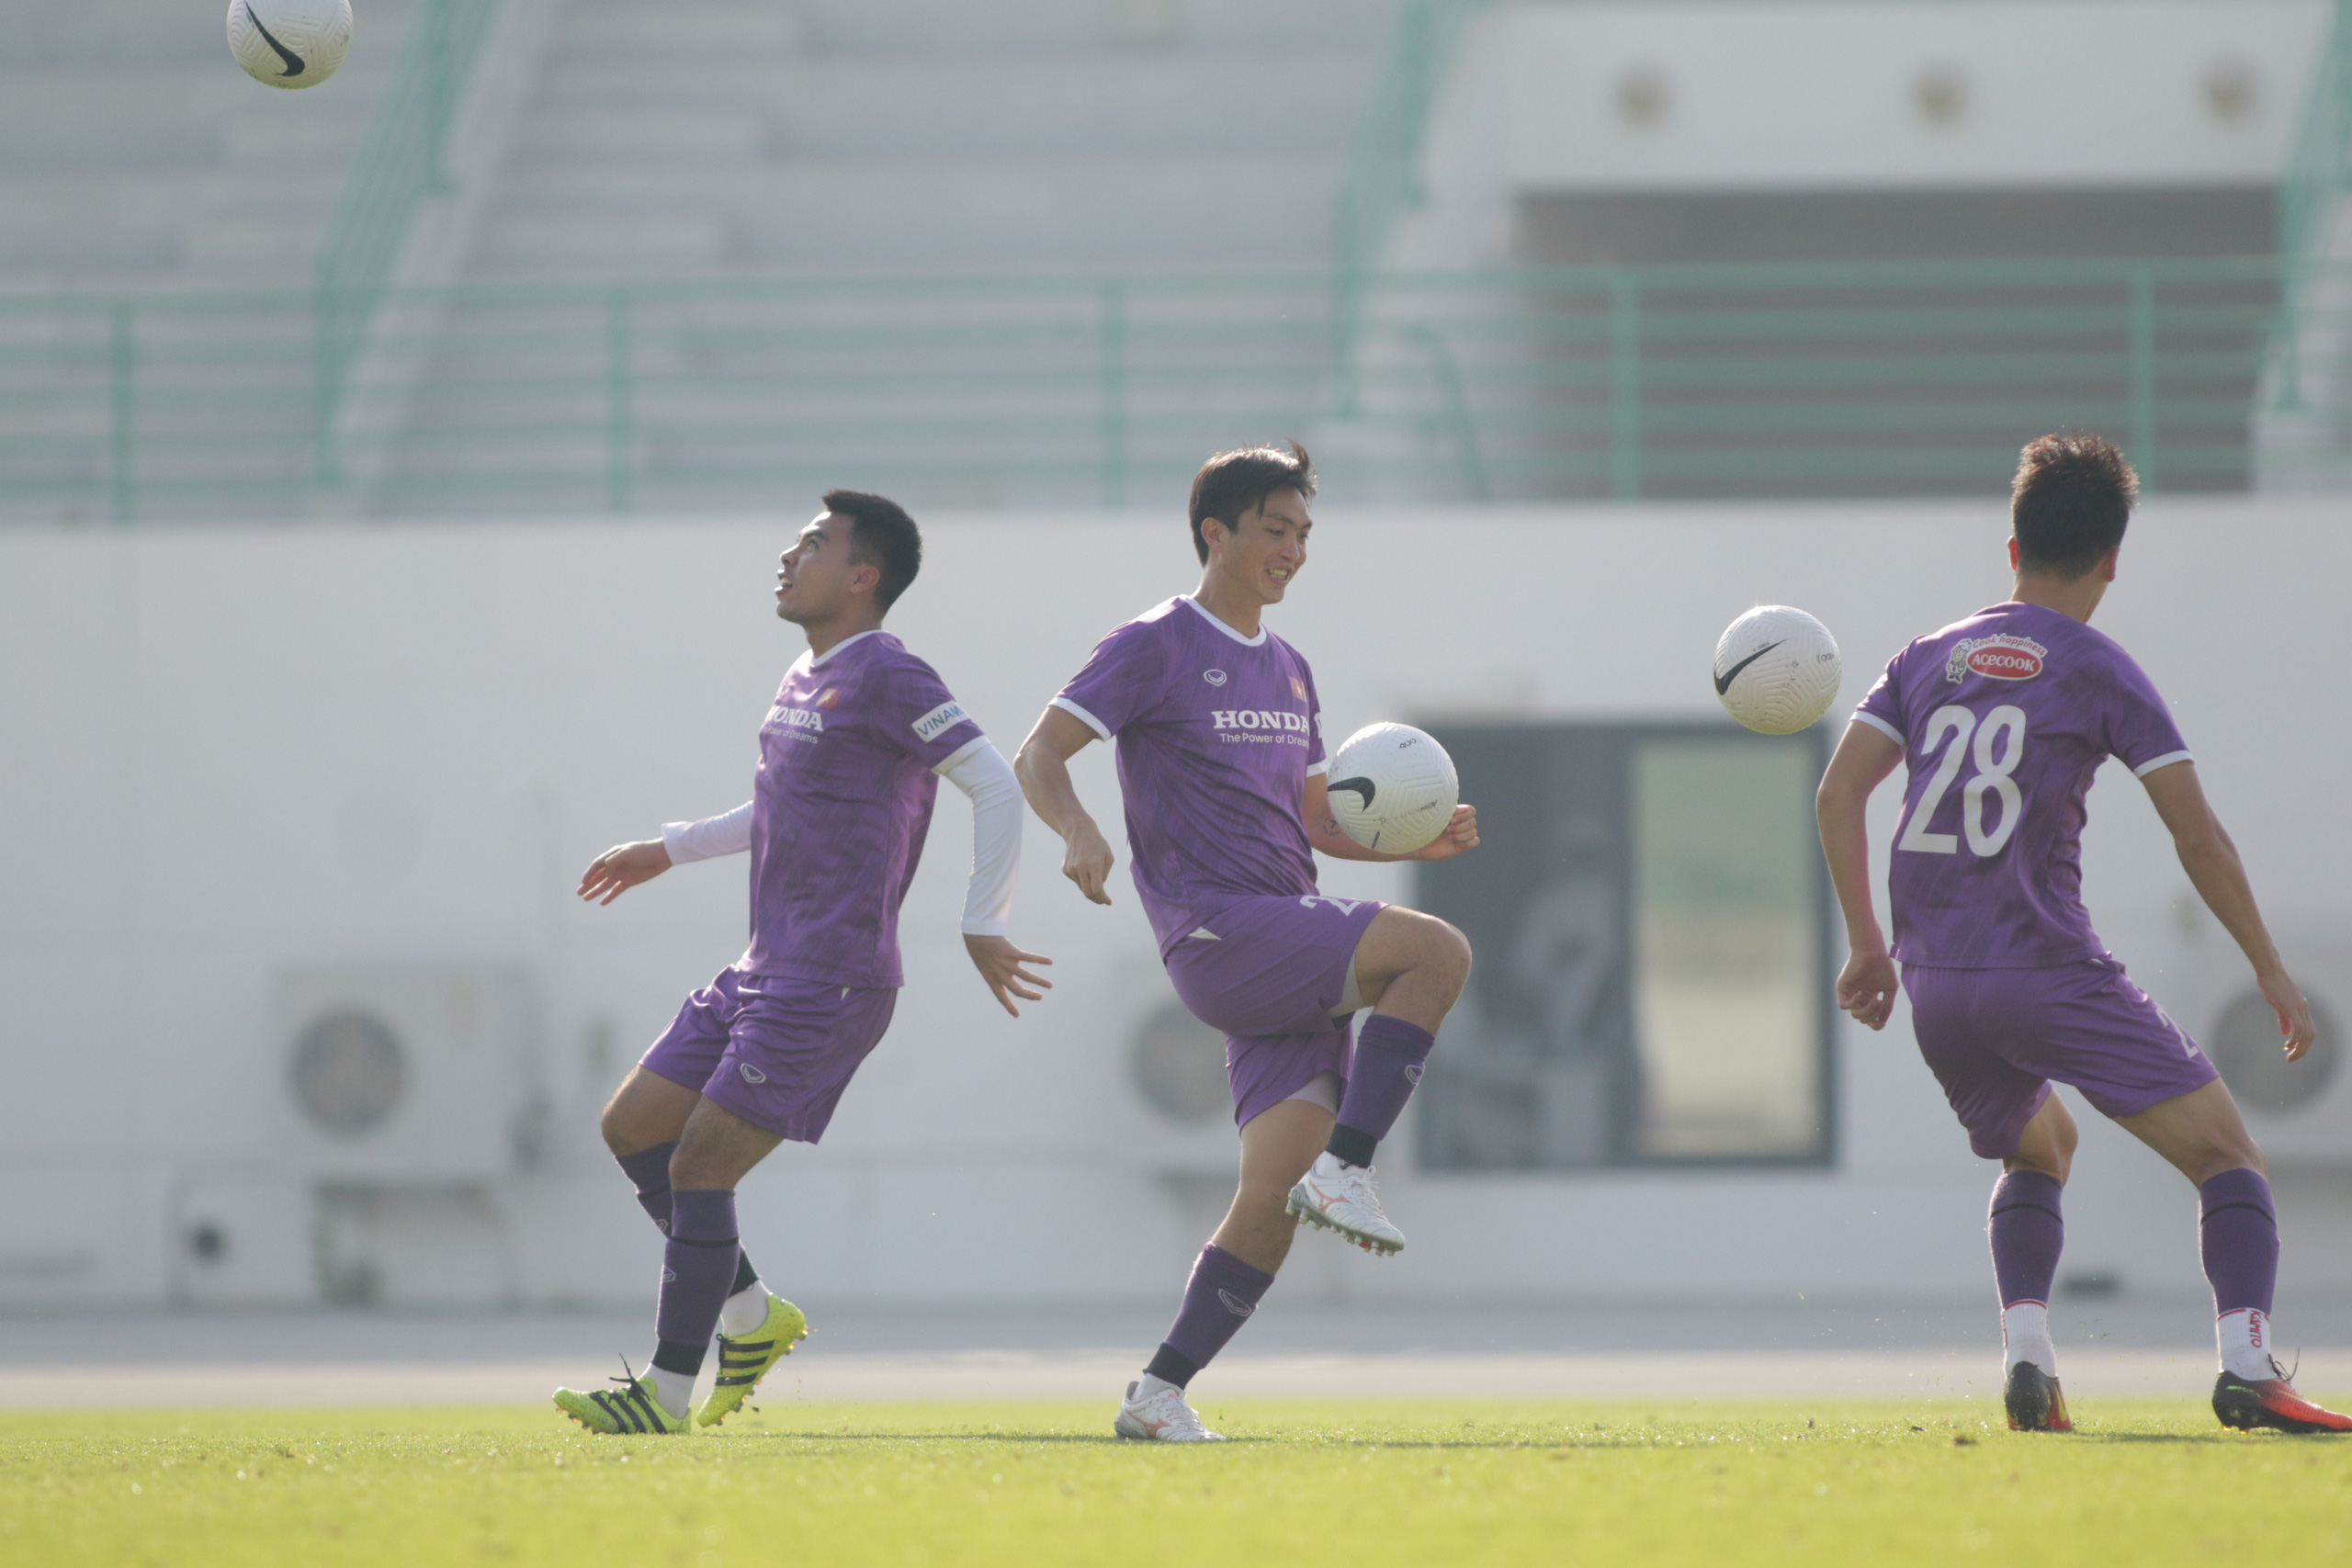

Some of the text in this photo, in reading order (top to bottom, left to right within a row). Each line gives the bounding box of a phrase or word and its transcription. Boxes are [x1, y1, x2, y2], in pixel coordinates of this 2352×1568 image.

[1998, 635, 2046, 656] happiness
[917, 705, 965, 736] VINAM
[1211, 710, 1310, 734] HONDA
[789, 729, 819, 744] Dreams
[1219, 733, 1240, 742] The
[1242, 733, 1273, 743] Power
[1275, 734, 1285, 744] of
[1898, 705, 2026, 857] 28
[2249, 1309, 2263, 1348] KAMITO
